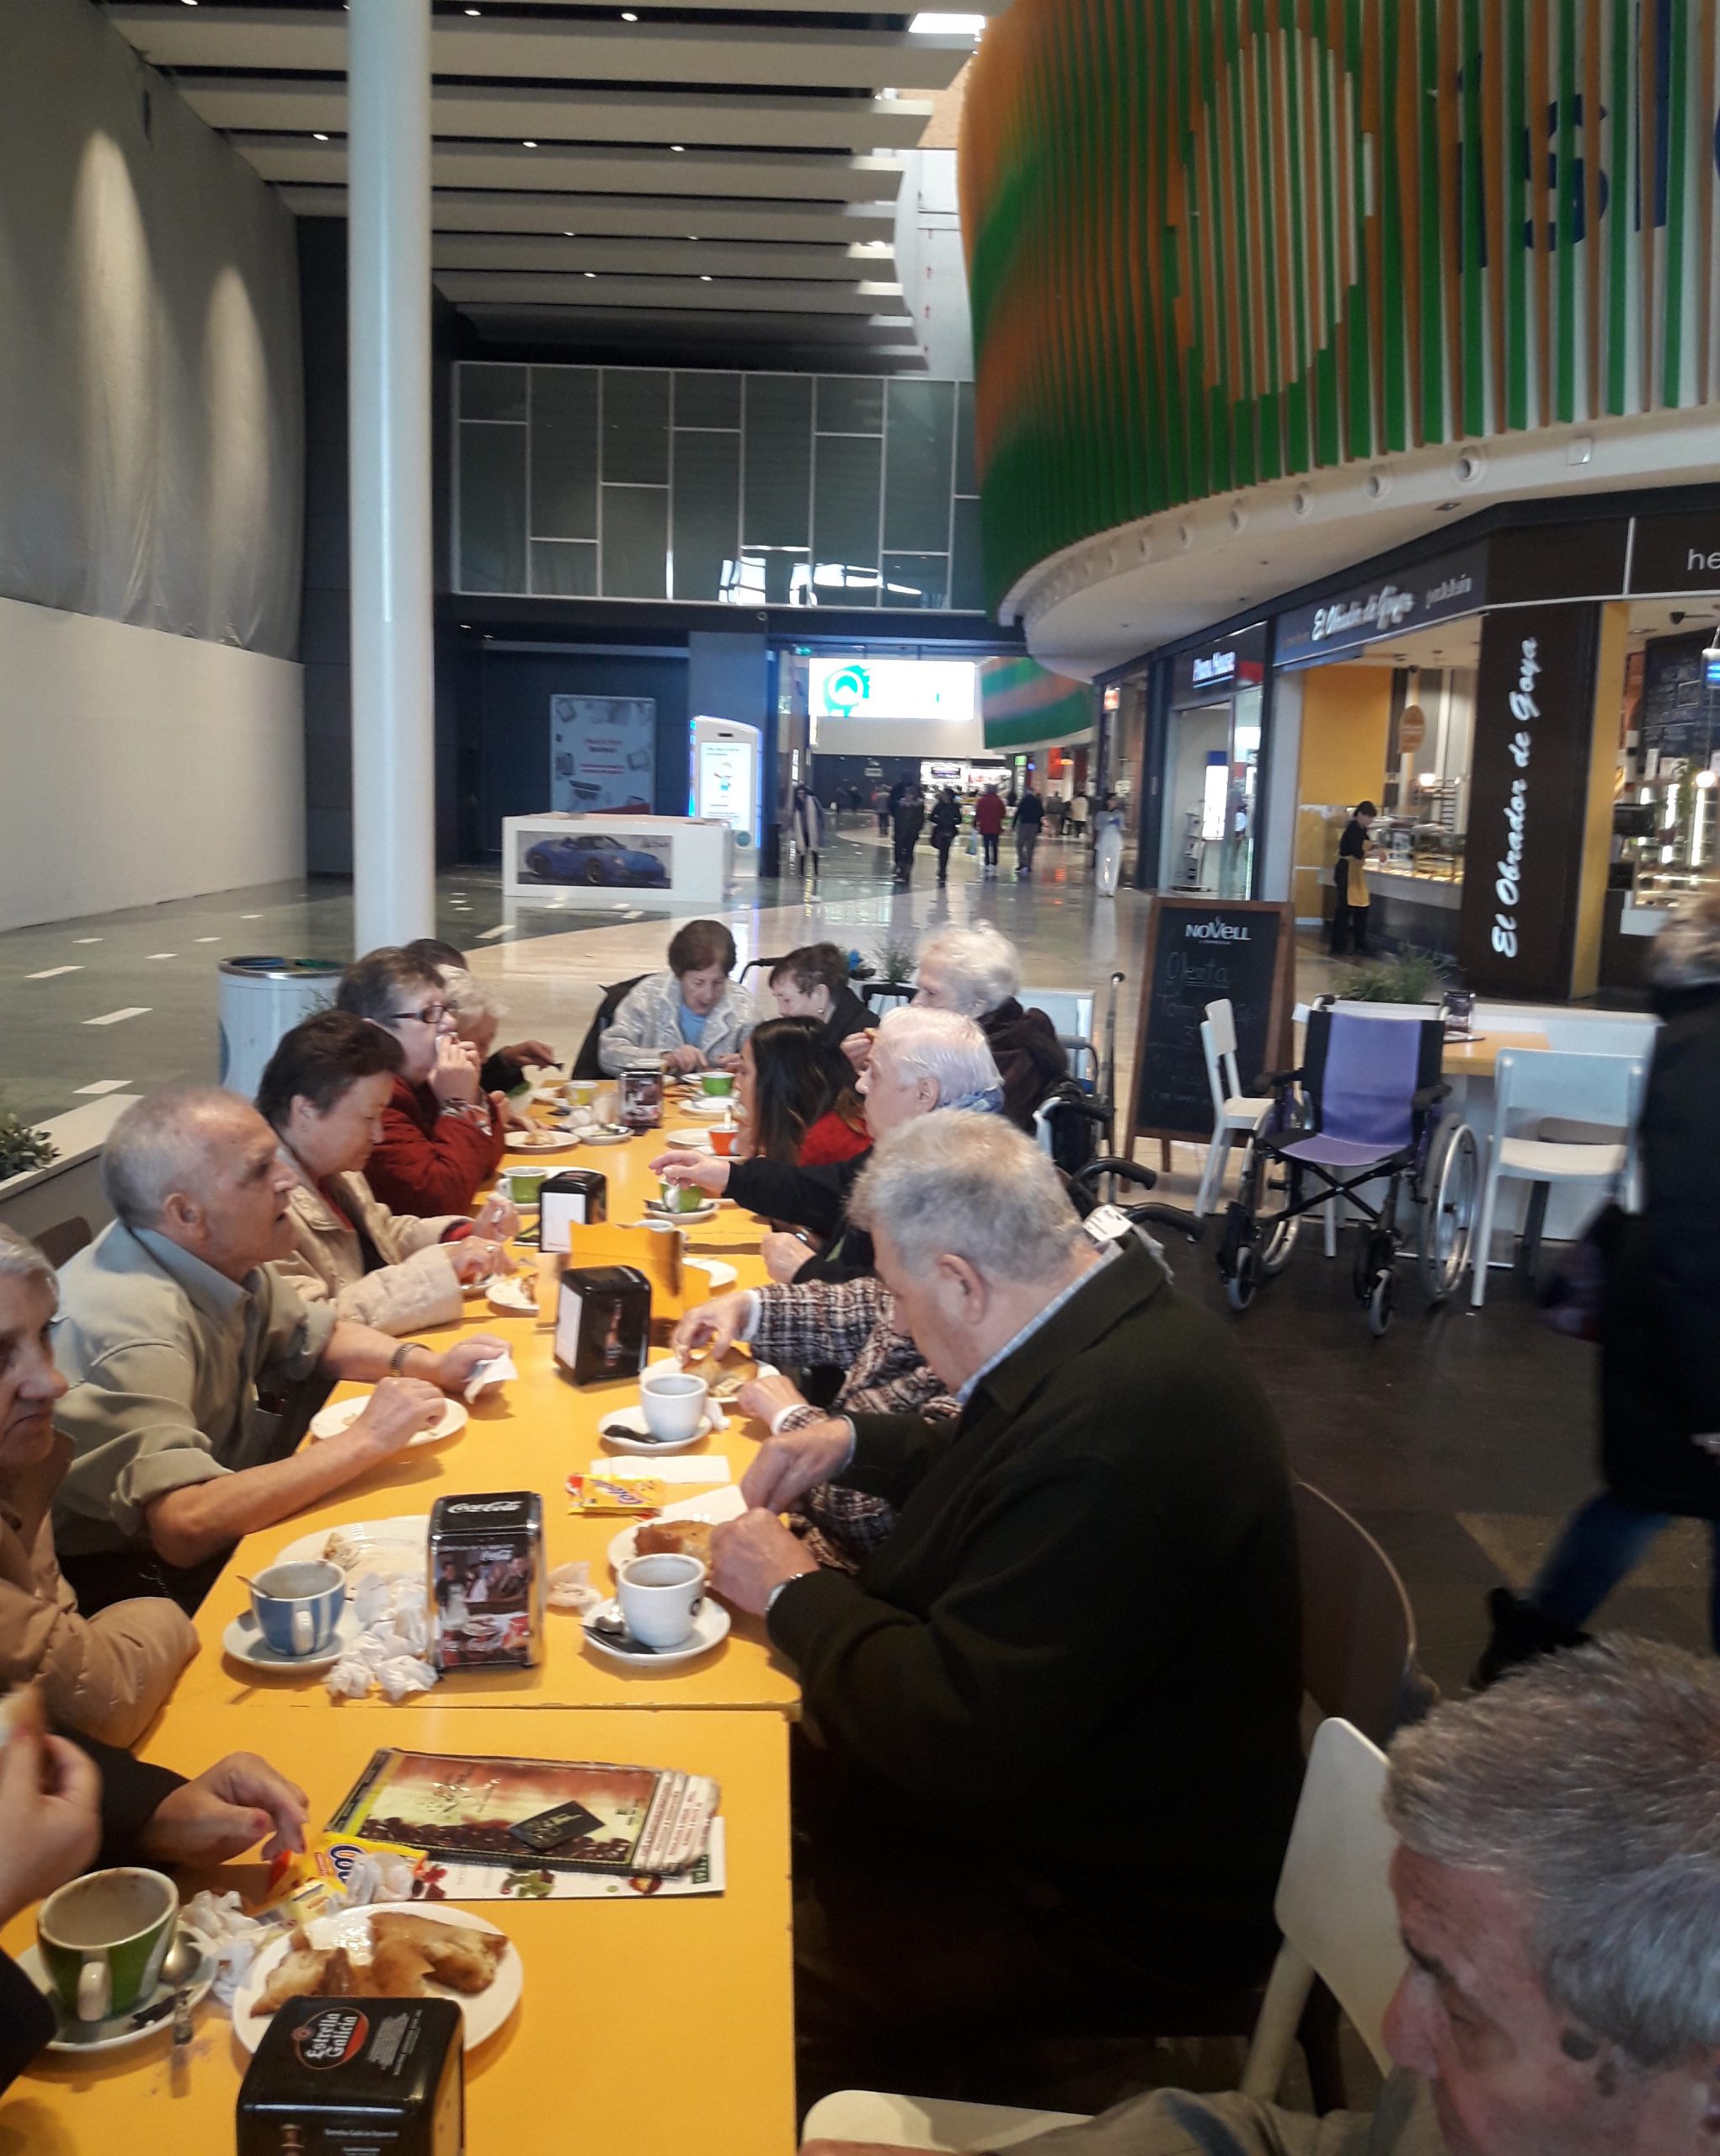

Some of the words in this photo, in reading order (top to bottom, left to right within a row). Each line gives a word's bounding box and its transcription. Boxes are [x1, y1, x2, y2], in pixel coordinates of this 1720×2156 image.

[1509, 636, 1543, 722] Goya
[1508, 730, 1531, 768] de
[1495, 776, 1529, 906] Obrador
[1490, 912, 1518, 958] El
[304, 2012, 342, 2060] Estrella
[325, 2015, 359, 2057] Galicia
